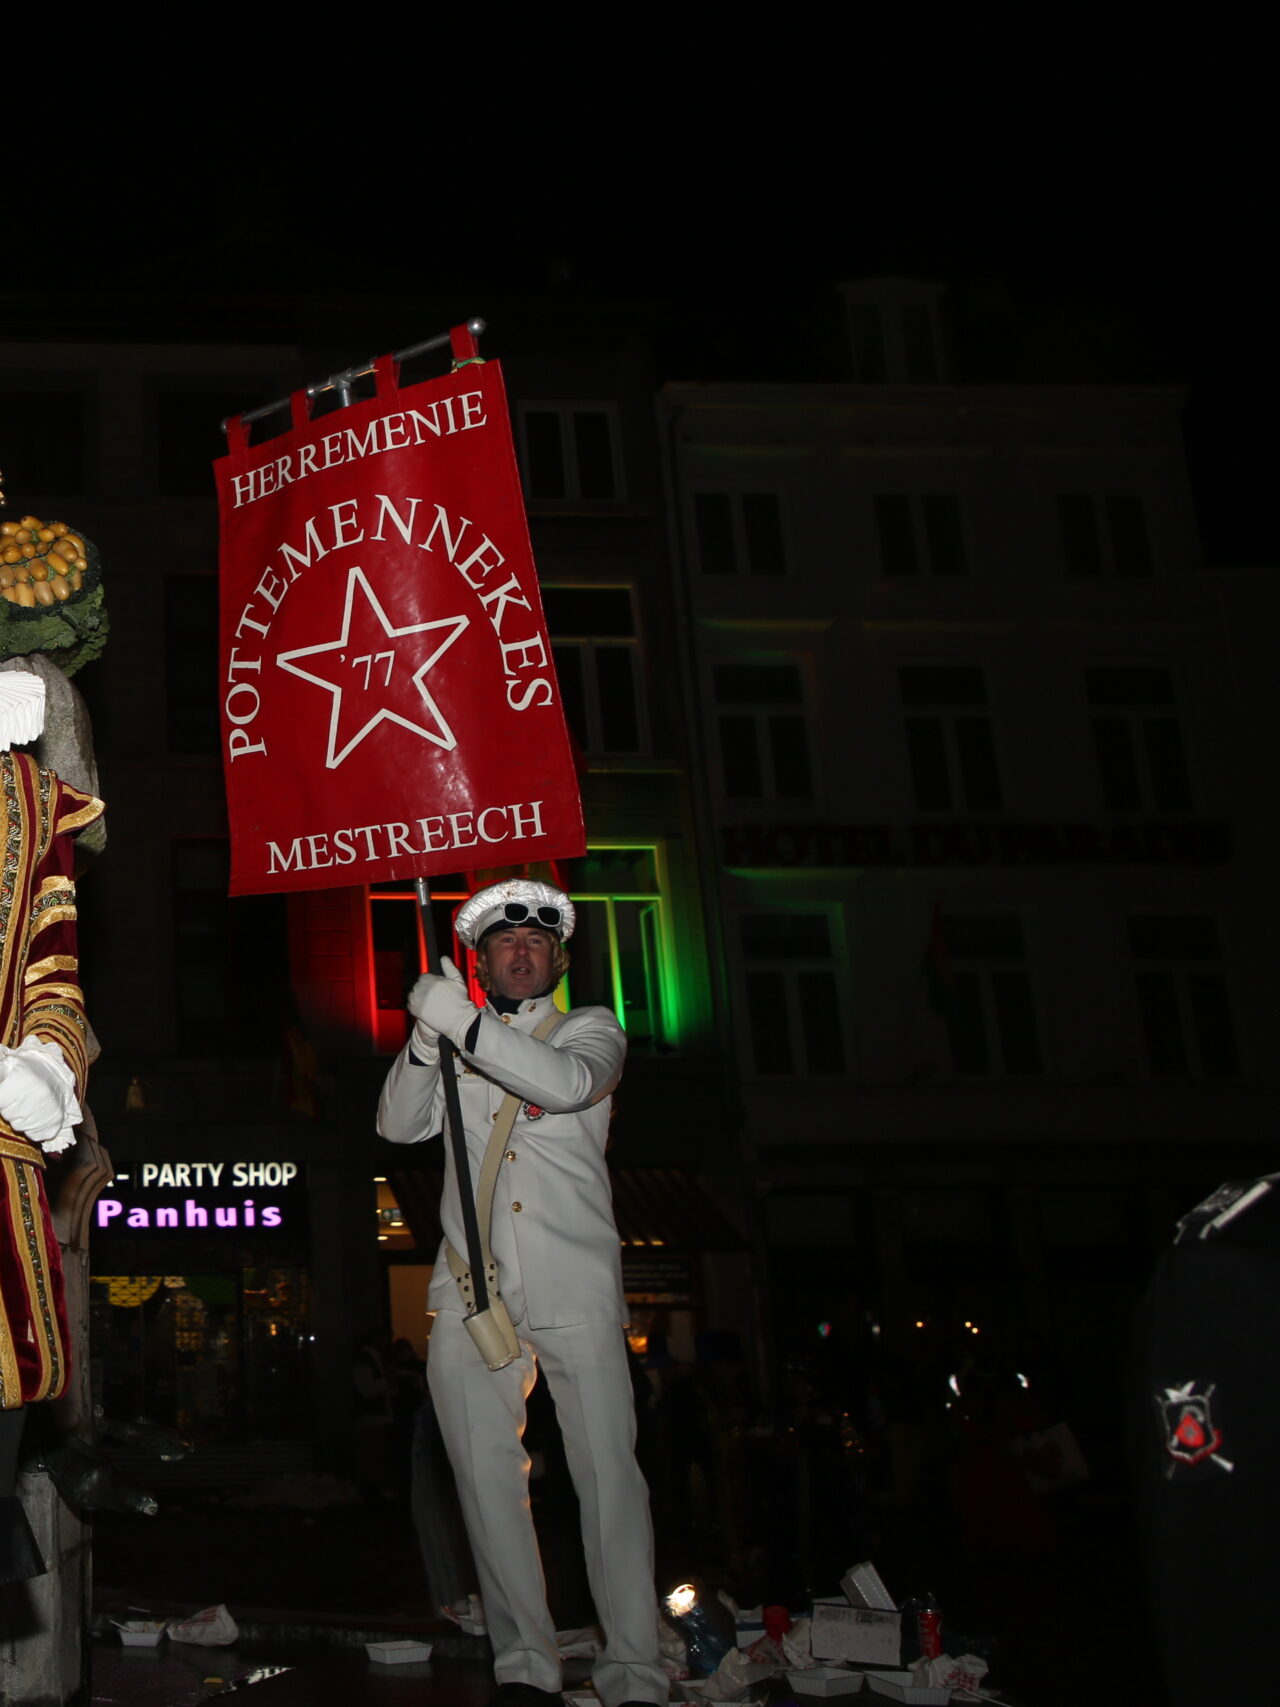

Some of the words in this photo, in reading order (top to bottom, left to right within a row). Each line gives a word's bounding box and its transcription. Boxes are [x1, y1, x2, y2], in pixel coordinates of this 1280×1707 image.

[230, 390, 488, 509] HERREMENIE
[225, 494, 553, 763] POTTEMENNEKES
[266, 801, 547, 874] MESTREECH
[142, 1163, 224, 1187] PARTY
[232, 1162, 297, 1187] SHOP
[98, 1199, 282, 1227] Panhuis
